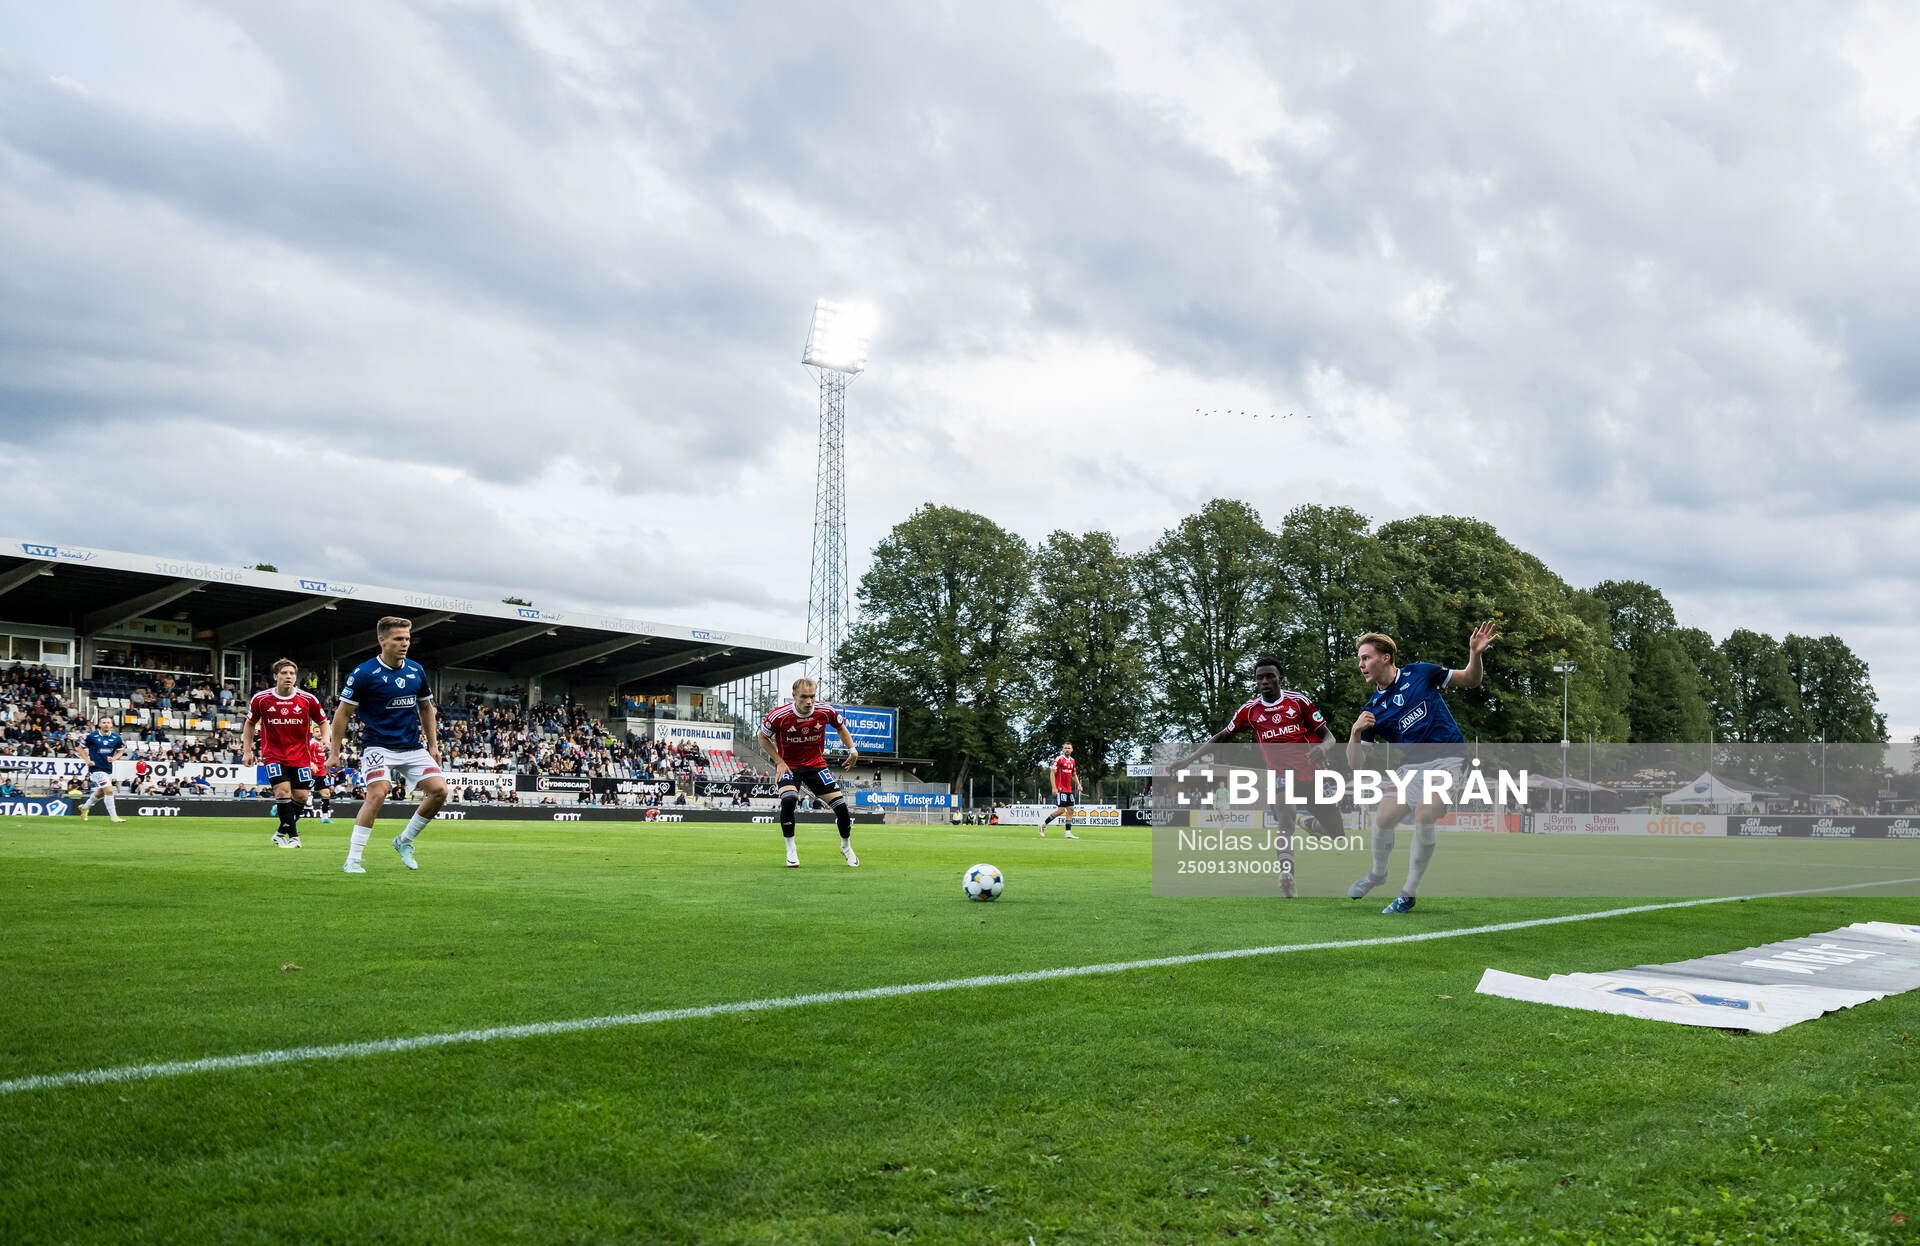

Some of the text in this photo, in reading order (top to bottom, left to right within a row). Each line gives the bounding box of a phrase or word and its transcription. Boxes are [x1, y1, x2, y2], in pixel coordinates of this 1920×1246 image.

[1401, 707, 1424, 729] JONAB
[845, 719, 886, 730] NILSSON
[671, 728, 731, 740] MOTORHALLAND
[1262, 724, 1300, 740] HOLMEN
[861, 740, 885, 749] Halmstad
[2, 760, 86, 776] NSKA LY
[203, 766, 239, 779] DOT
[540, 779, 590, 789] HYDROSCAND
[617, 781, 660, 794] villalivet
[904, 794, 933, 805] Fönster
[935, 796, 945, 805] AB
[1010, 809, 1040, 818] STIGMA
[1136, 810, 1173, 822] ClickitUp
[1213, 813, 1249, 823] weber
[1551, 815, 1573, 825] Bygg
[1593, 816, 1615, 826] Bygg
[1646, 816, 1707, 835] office
[1746, 818, 1760, 826] GN
[1818, 818, 1833, 827] GN
[1894, 820, 1910, 828] GN
[1740, 824, 1782, 834] Transport
[1812, 825, 1856, 836] Transport
[1887, 825, 1920, 836] Transp
